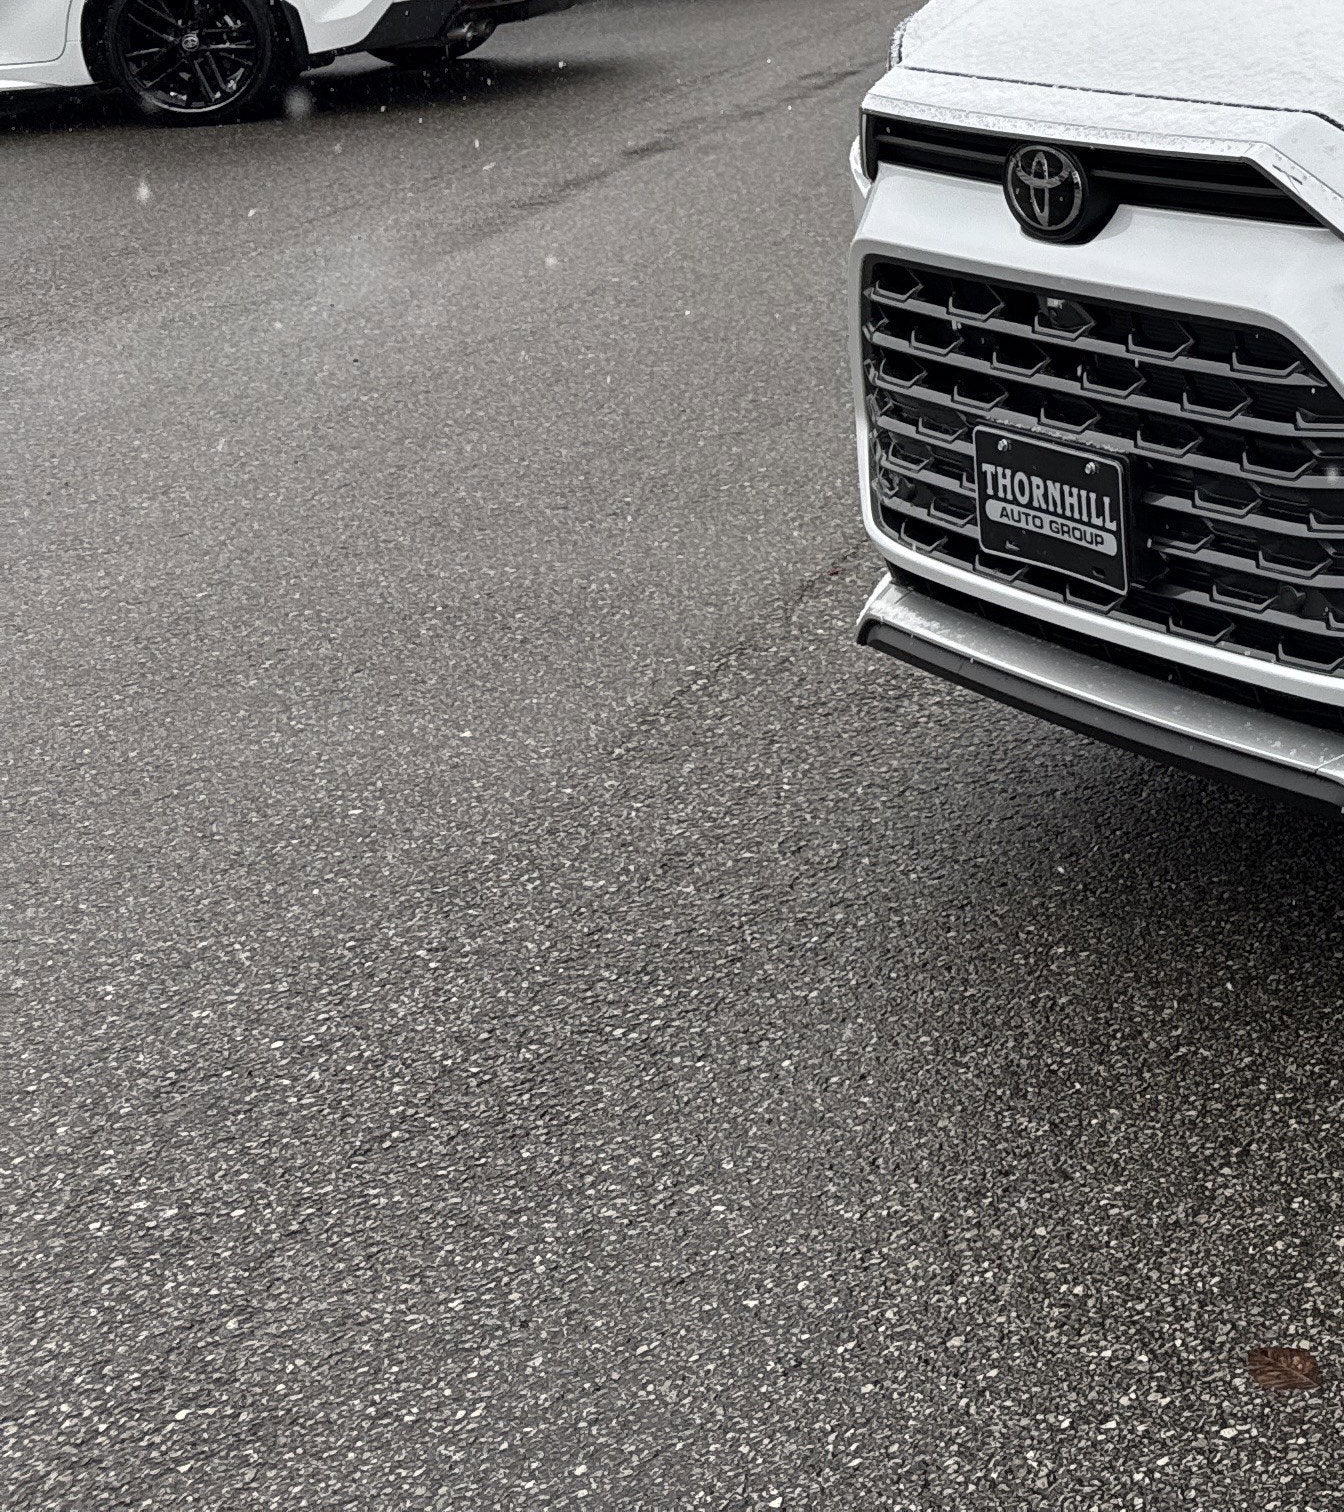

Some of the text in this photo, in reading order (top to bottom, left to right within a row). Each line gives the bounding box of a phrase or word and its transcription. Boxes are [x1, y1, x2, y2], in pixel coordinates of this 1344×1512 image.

[981, 462, 1117, 531] THORNHILL
[1000, 506, 1104, 547] AUTO GROUP
